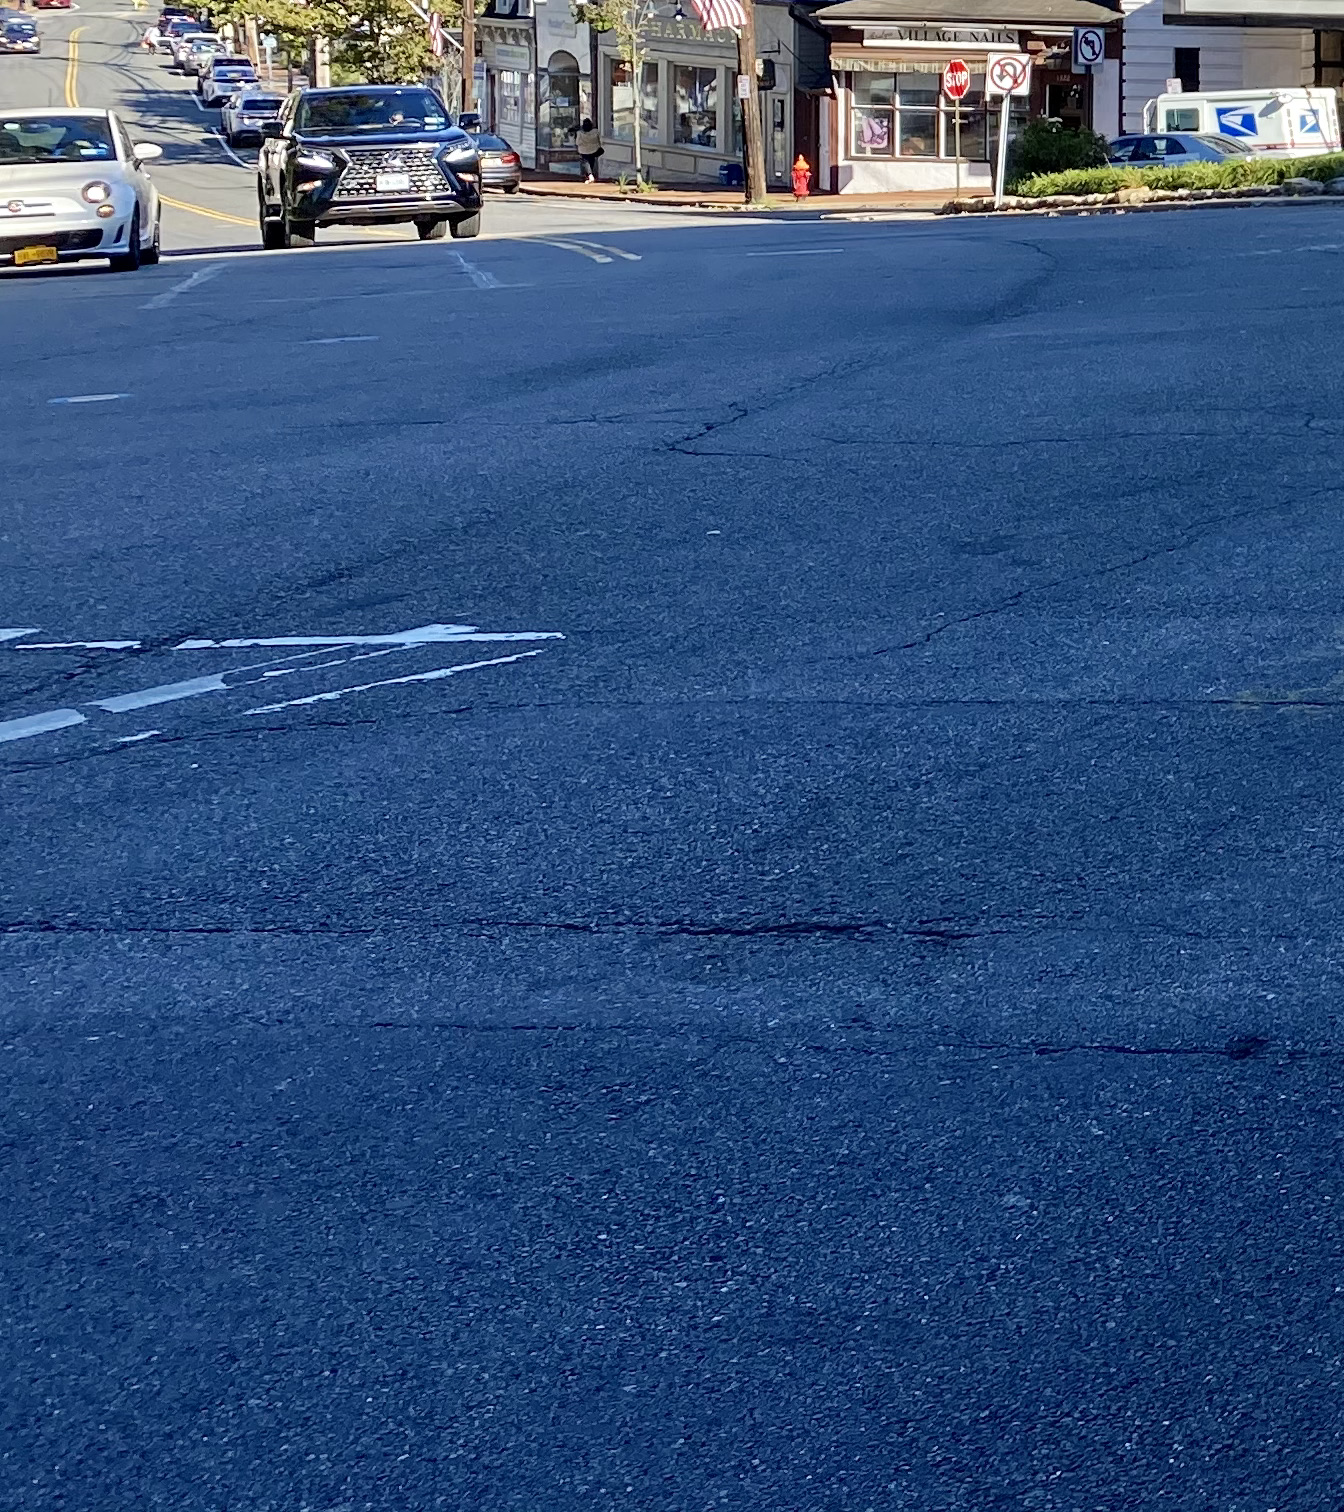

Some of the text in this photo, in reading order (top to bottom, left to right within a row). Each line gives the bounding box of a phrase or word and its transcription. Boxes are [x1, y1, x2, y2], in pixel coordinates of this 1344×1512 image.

[897, 30, 961, 42] VILLAGE
[969, 31, 1015, 44] NAILS
[946, 71, 968, 87] STOP
